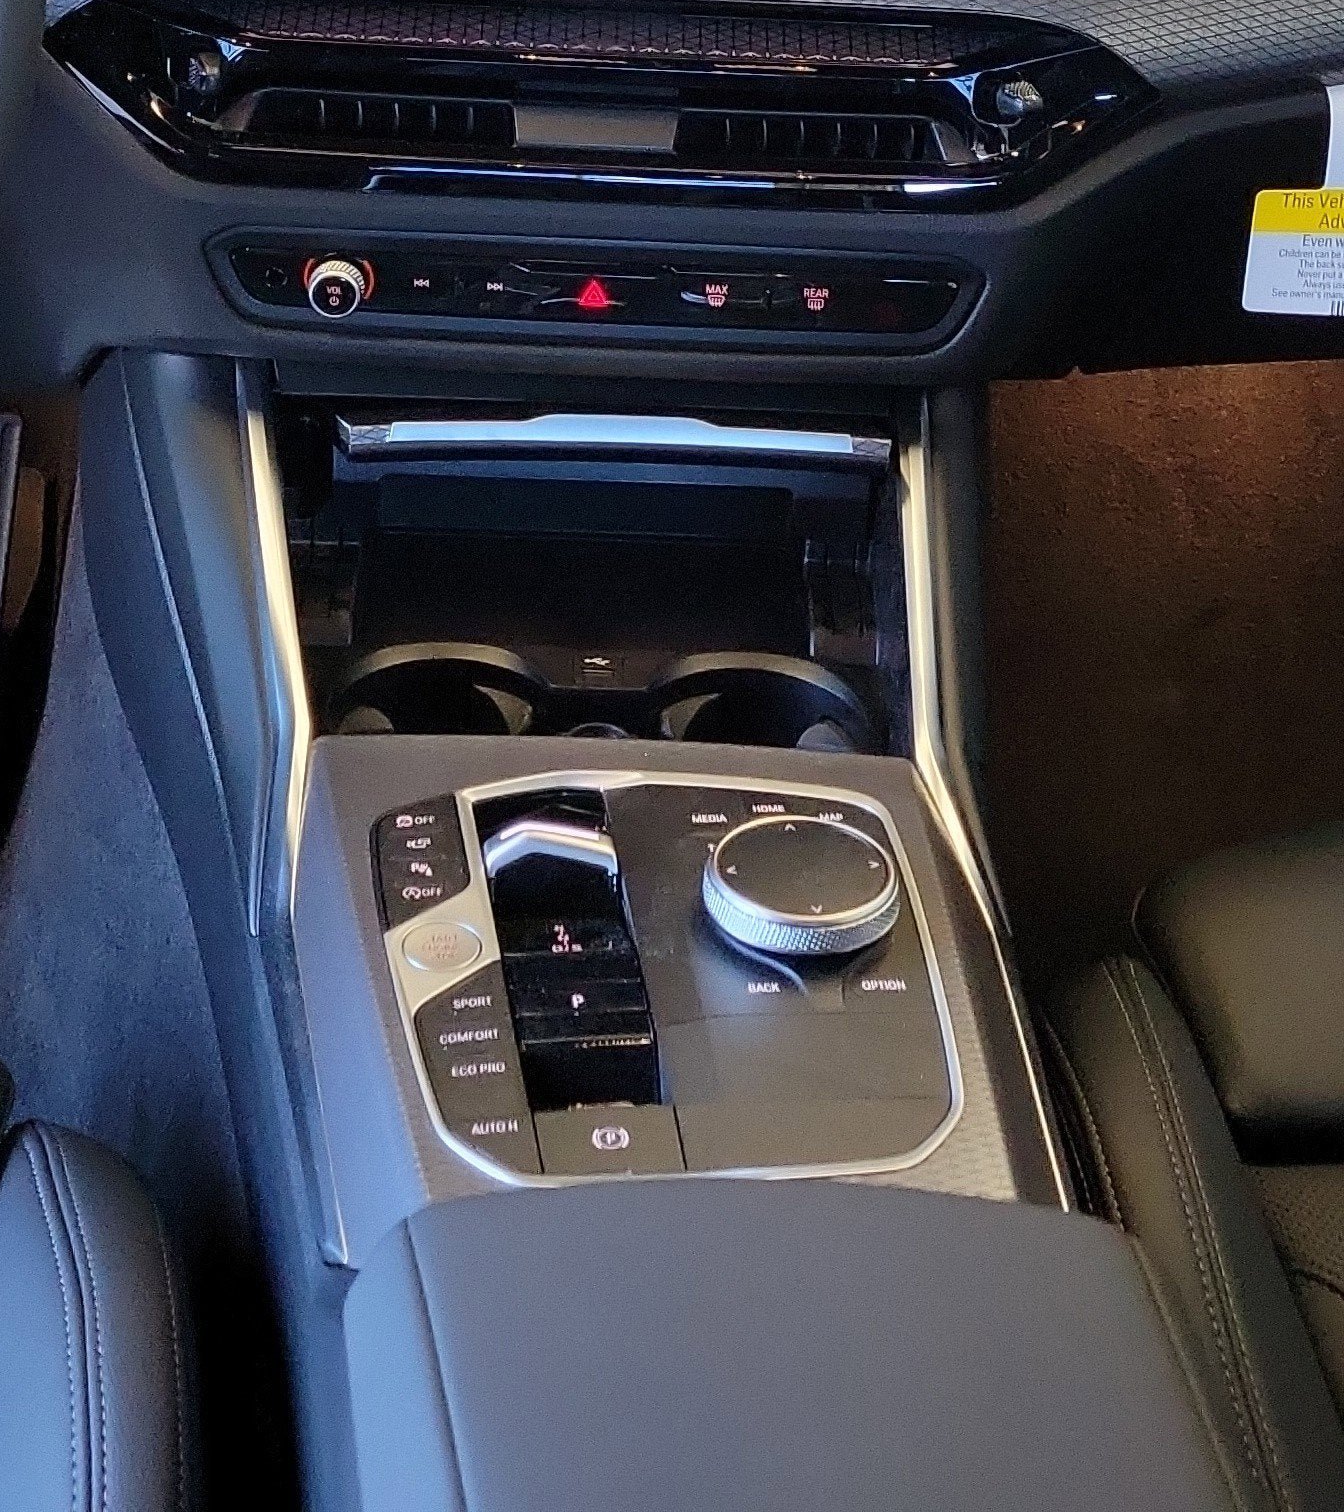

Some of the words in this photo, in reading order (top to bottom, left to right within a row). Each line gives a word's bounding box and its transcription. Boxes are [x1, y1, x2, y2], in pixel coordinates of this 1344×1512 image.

[1283, 192, 1315, 209] This
[1302, 233, 1332, 248] Even
[1278, 249, 1313, 259] Children
[1315, 251, 1330, 259] can
[1331, 250, 1342, 259] be
[1299, 259, 1315, 269] The
[1316, 259, 1336, 269] back
[1297, 269, 1320, 279] Never
[1322, 271, 1337, 280] put
[326, 285, 342, 295] VOL
[705, 283, 729, 295] MAX
[1303, 279, 1331, 290] Always
[803, 288, 829, 299] REAR
[1271, 288, 1289, 298] See
[1289, 290, 1322, 299] owner's
[752, 804, 785, 813] HOME
[415, 815, 435, 825] OFF
[691, 813, 728, 824] MEDIA
[748, 981, 781, 993] BACK
[861, 979, 907, 992] OPTION
[452, 995, 493, 1009] SPORT
[571, 993, 585, 1009] P
[439, 1028, 499, 1045] COMFORT
[451, 1065, 477, 1078] ECO
